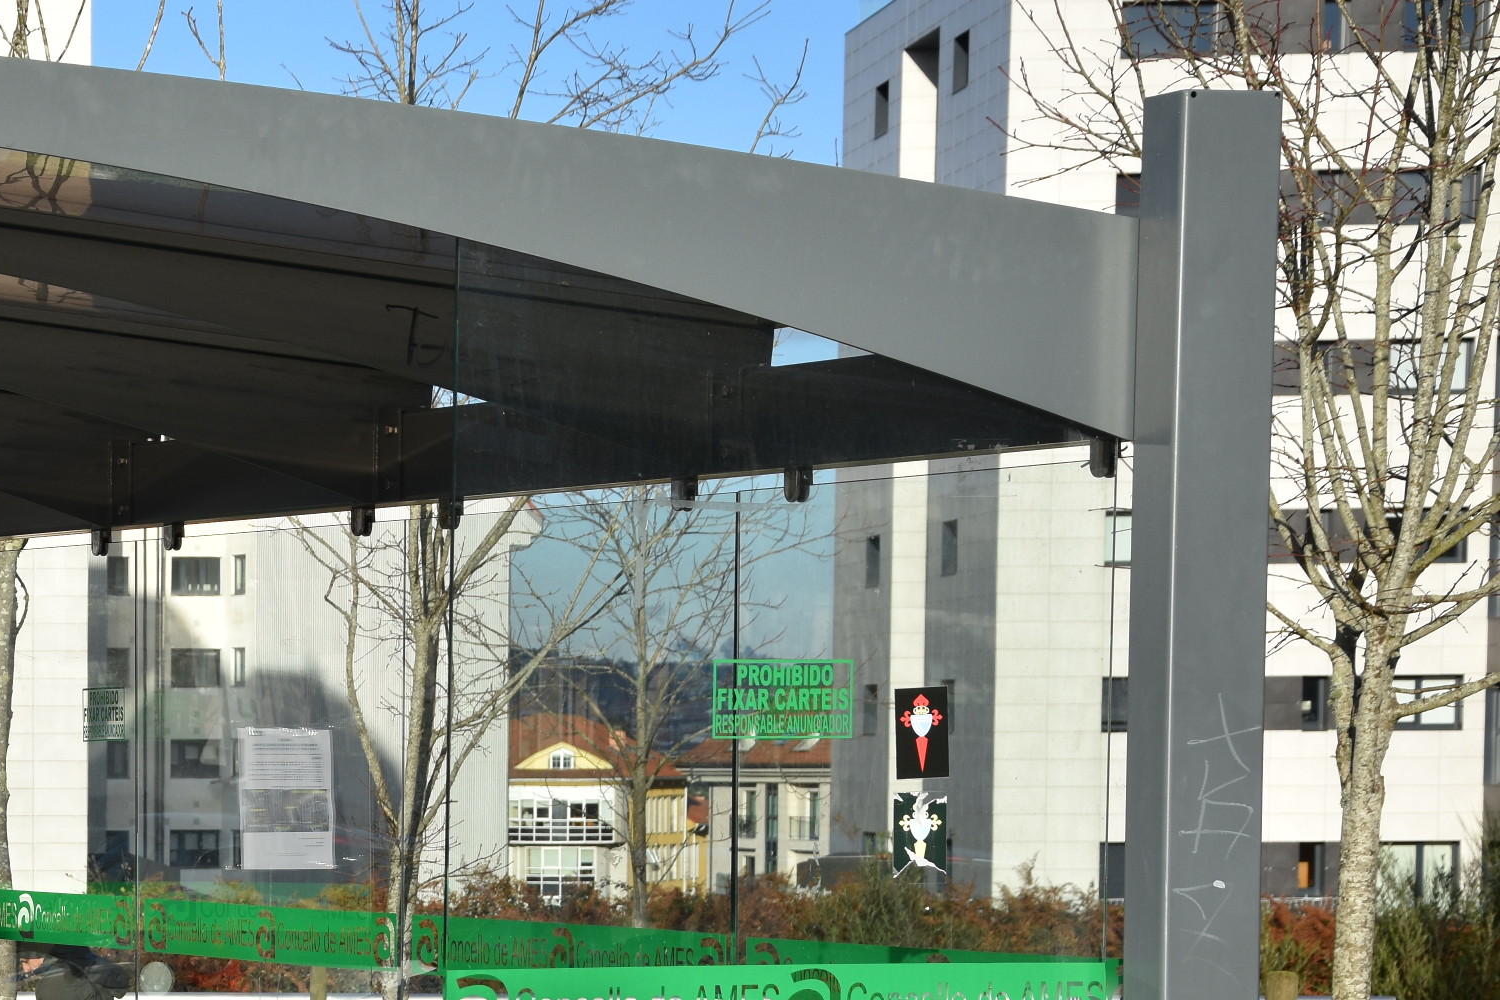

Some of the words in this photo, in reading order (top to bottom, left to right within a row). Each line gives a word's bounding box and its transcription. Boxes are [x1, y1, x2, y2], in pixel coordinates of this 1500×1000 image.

[736, 664, 834, 686] PROHIBIDO
[89, 690, 119, 705] PROHIBIDO
[717, 688, 770, 711] FIXAR
[774, 688, 850, 711] CARTEIS
[100, 706, 124, 721] CARTEIS
[714, 714, 785, 734] RESPONSABLE
[786, 714, 849, 733] ANUNCIADOR
[167, 914, 207, 943] Concello
[210, 916, 222, 945] de
[223, 917, 256, 947] AMES
[277, 922, 321, 953] Concello
[323, 924, 337, 953] de
[339, 926, 373, 956] AMES
[441, 934, 491, 966] Concello
[493, 936, 508, 966] de
[511, 936, 548, 968] AMES
[576, 940, 630, 967] Concello
[634, 944, 650, 966] de
[653, 946, 694, 966] AMES
